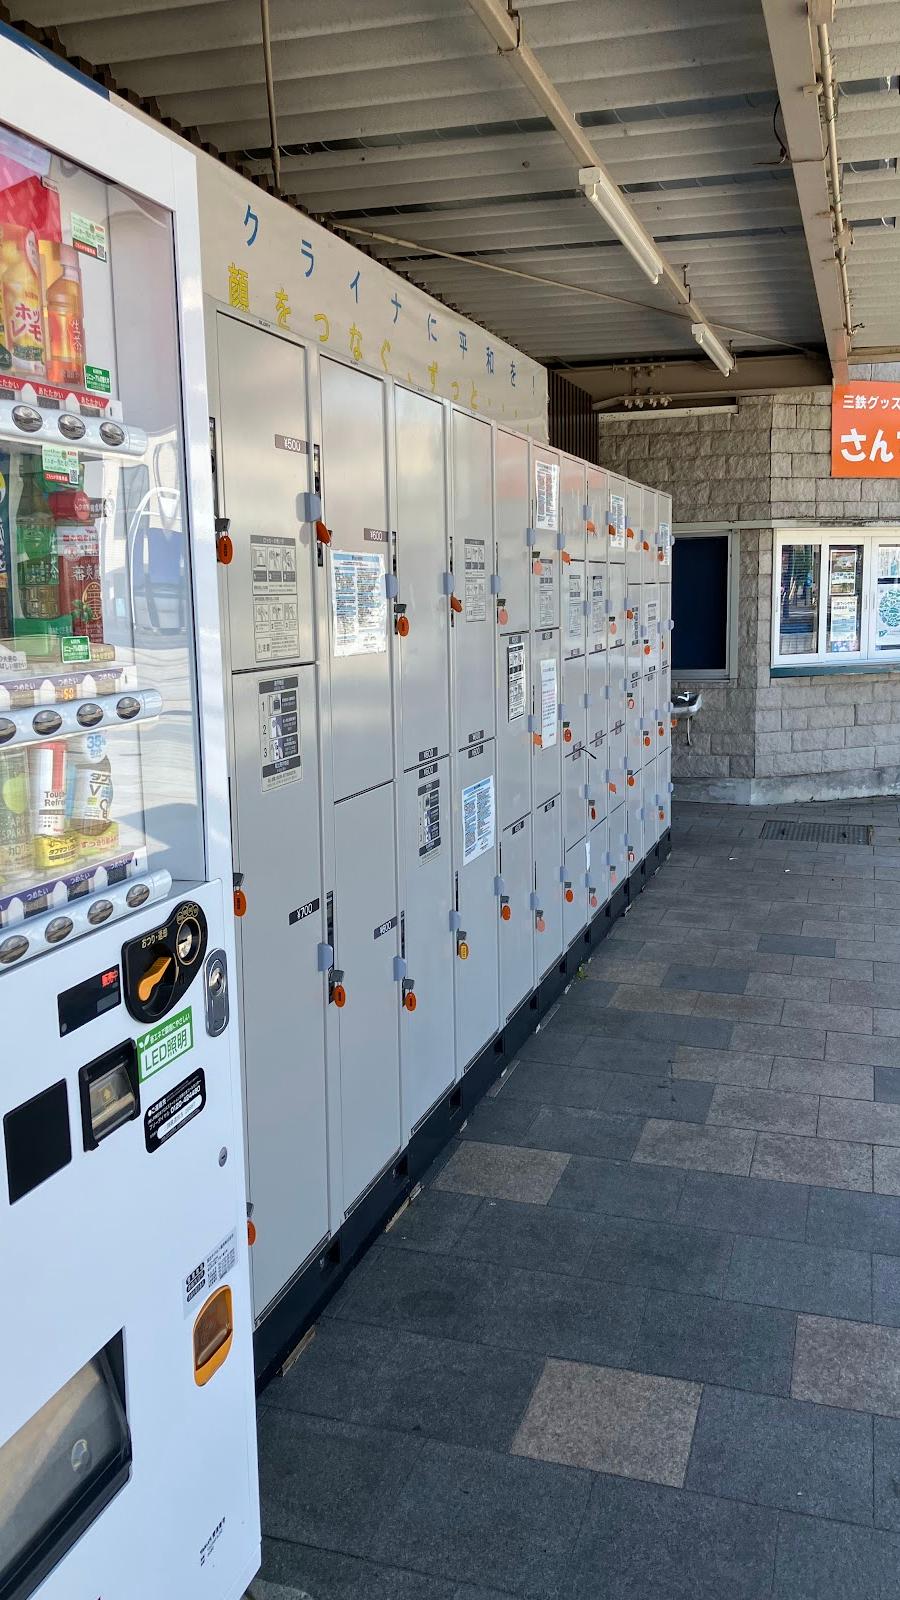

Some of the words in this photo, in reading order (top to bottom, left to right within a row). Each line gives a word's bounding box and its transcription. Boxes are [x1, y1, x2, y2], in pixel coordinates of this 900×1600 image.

[283, 437, 301, 452] ¥500
[840, 427, 900, 463] さん
[368, 529, 383, 542] ¥600
[296, 902, 313, 920] ¥700
[145, 1028, 187, 1071] LED照明
